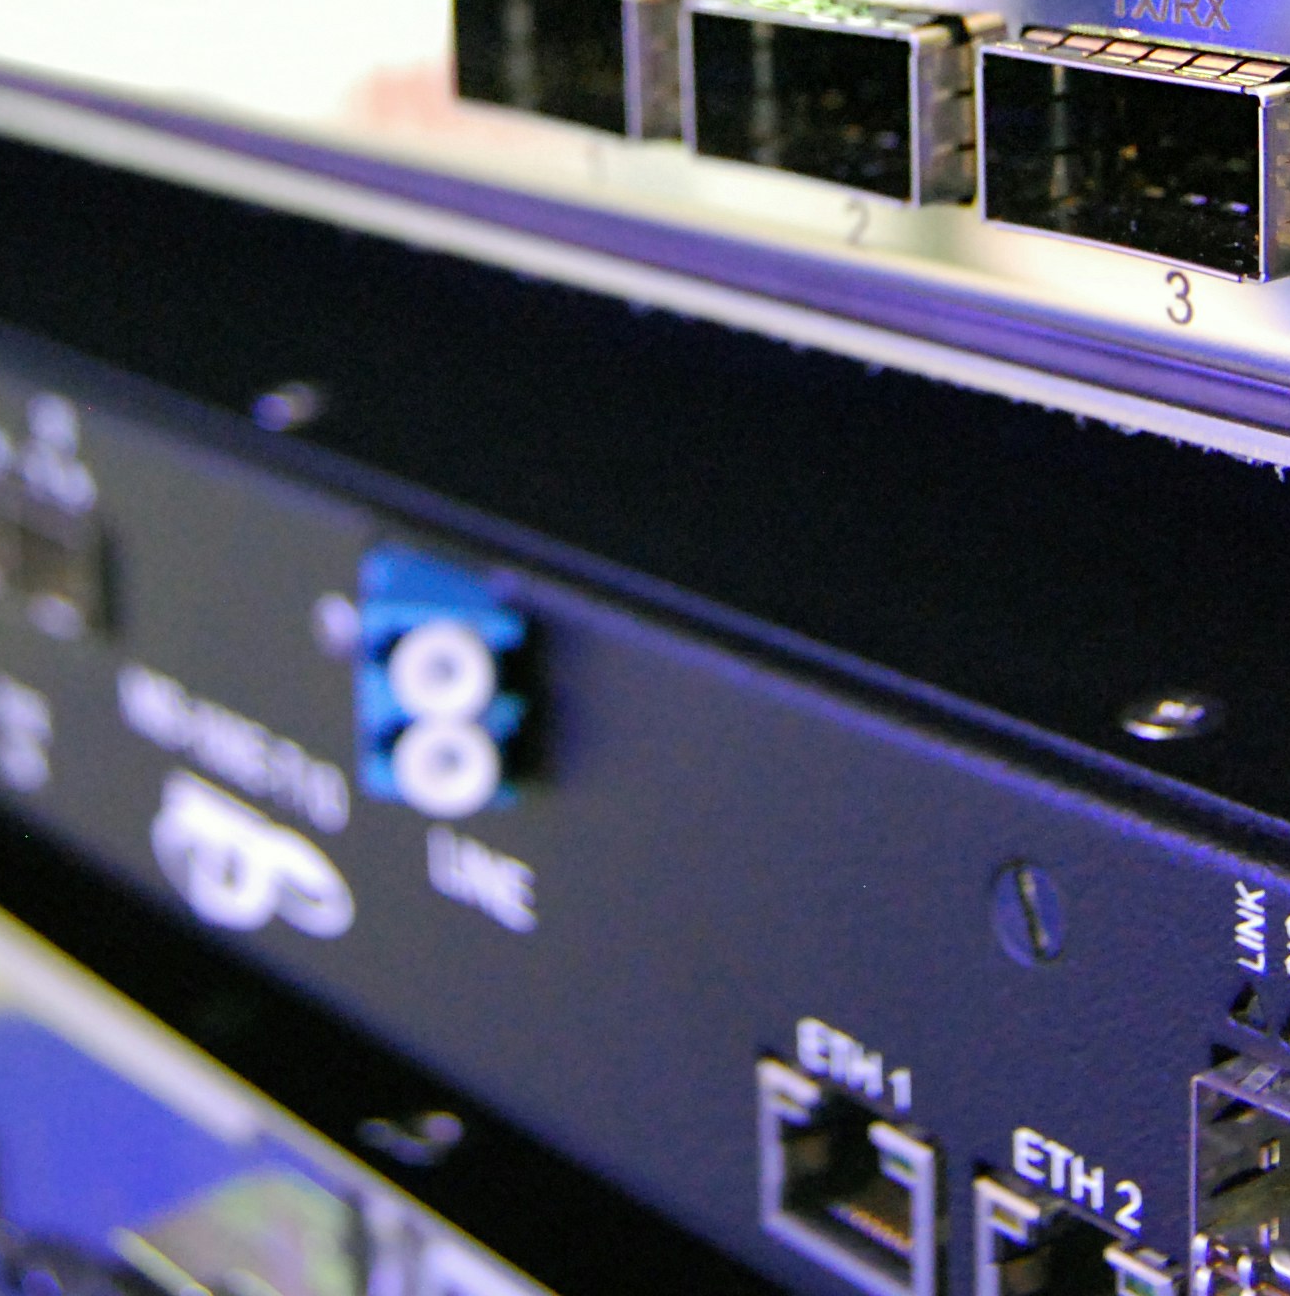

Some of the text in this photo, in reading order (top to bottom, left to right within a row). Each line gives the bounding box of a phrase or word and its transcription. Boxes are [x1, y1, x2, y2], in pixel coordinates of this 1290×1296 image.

[1165, 270, 1193, 326] 3
[1234, 880, 1266, 975] LINK
[796, 1016, 913, 1115] ETH 1
[1012, 1126, 1144, 1237] ETH 2
